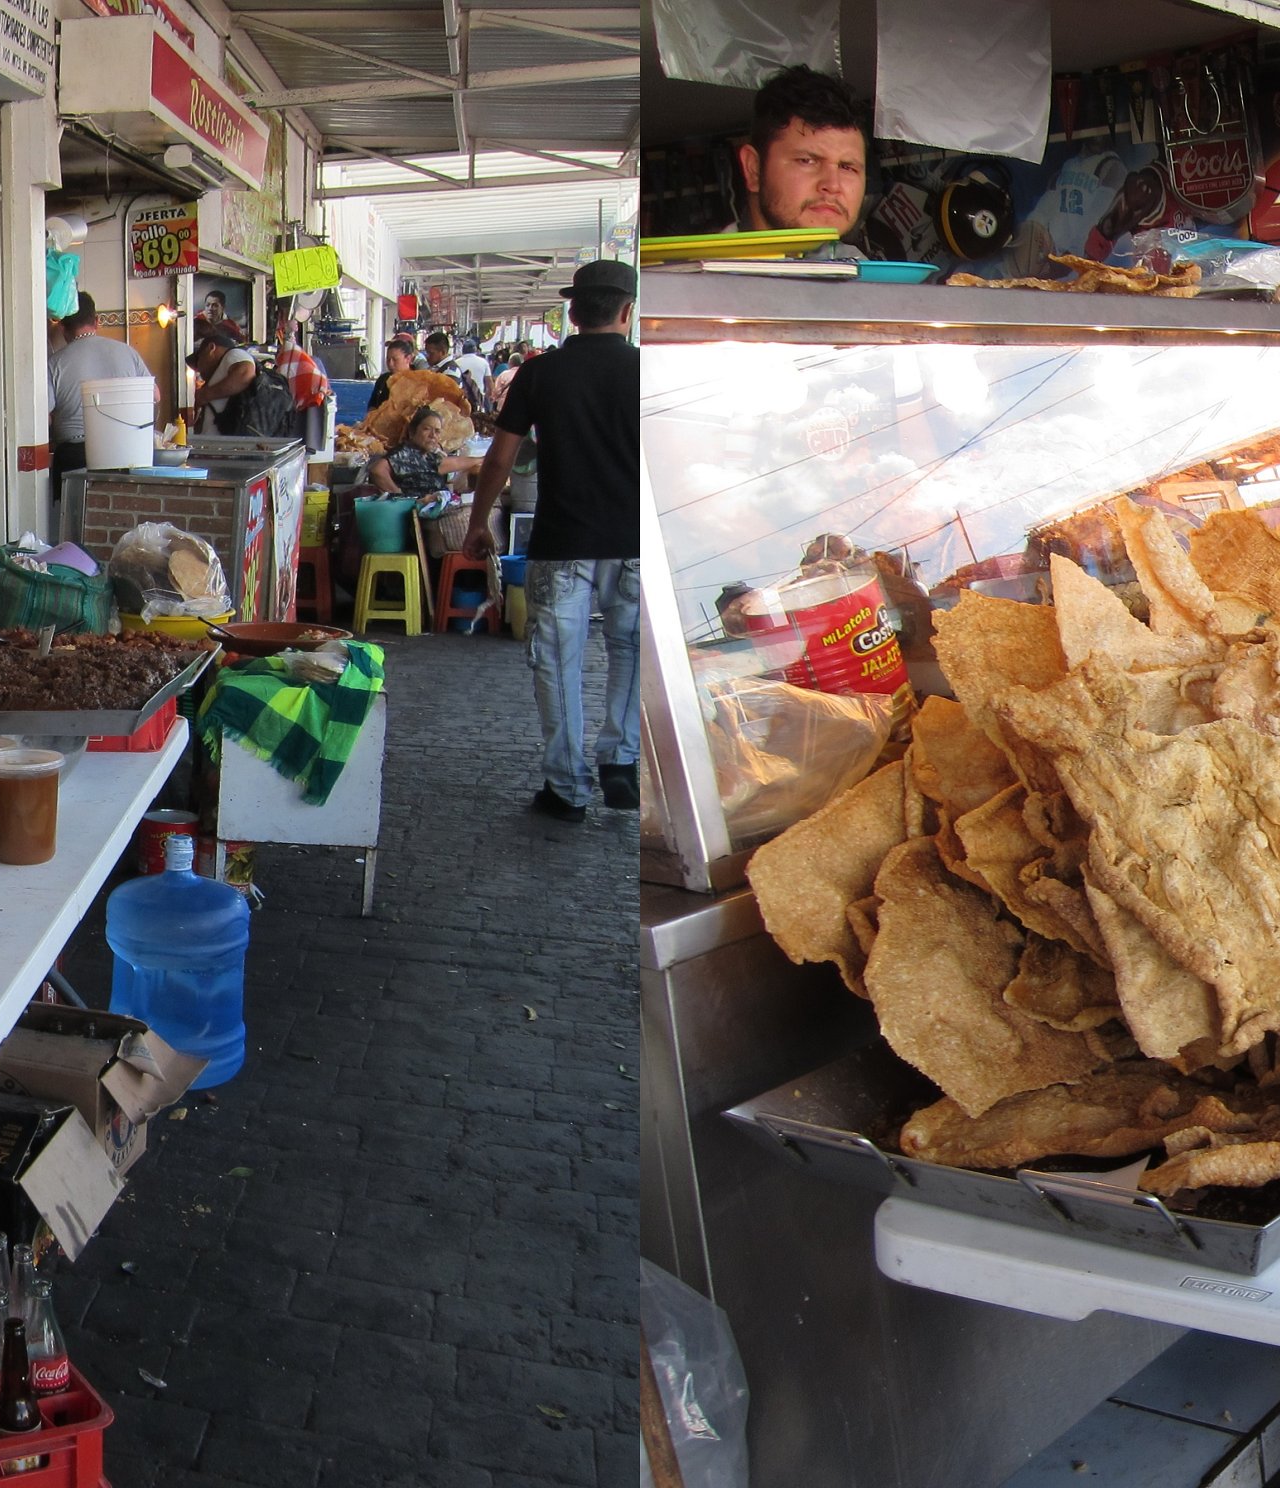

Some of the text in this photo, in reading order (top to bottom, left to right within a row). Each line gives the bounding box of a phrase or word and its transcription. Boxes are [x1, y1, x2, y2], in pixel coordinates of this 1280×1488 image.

[1181, 149, 1242, 179] Coors
[1060, 188, 1083, 215] 12
[131, 224, 167, 244] Pollo
[1178, 231, 1195, 241] 500
[164, 265, 196, 276] Rostizado
[1192, 1281, 1259, 1299] LIFETIME
